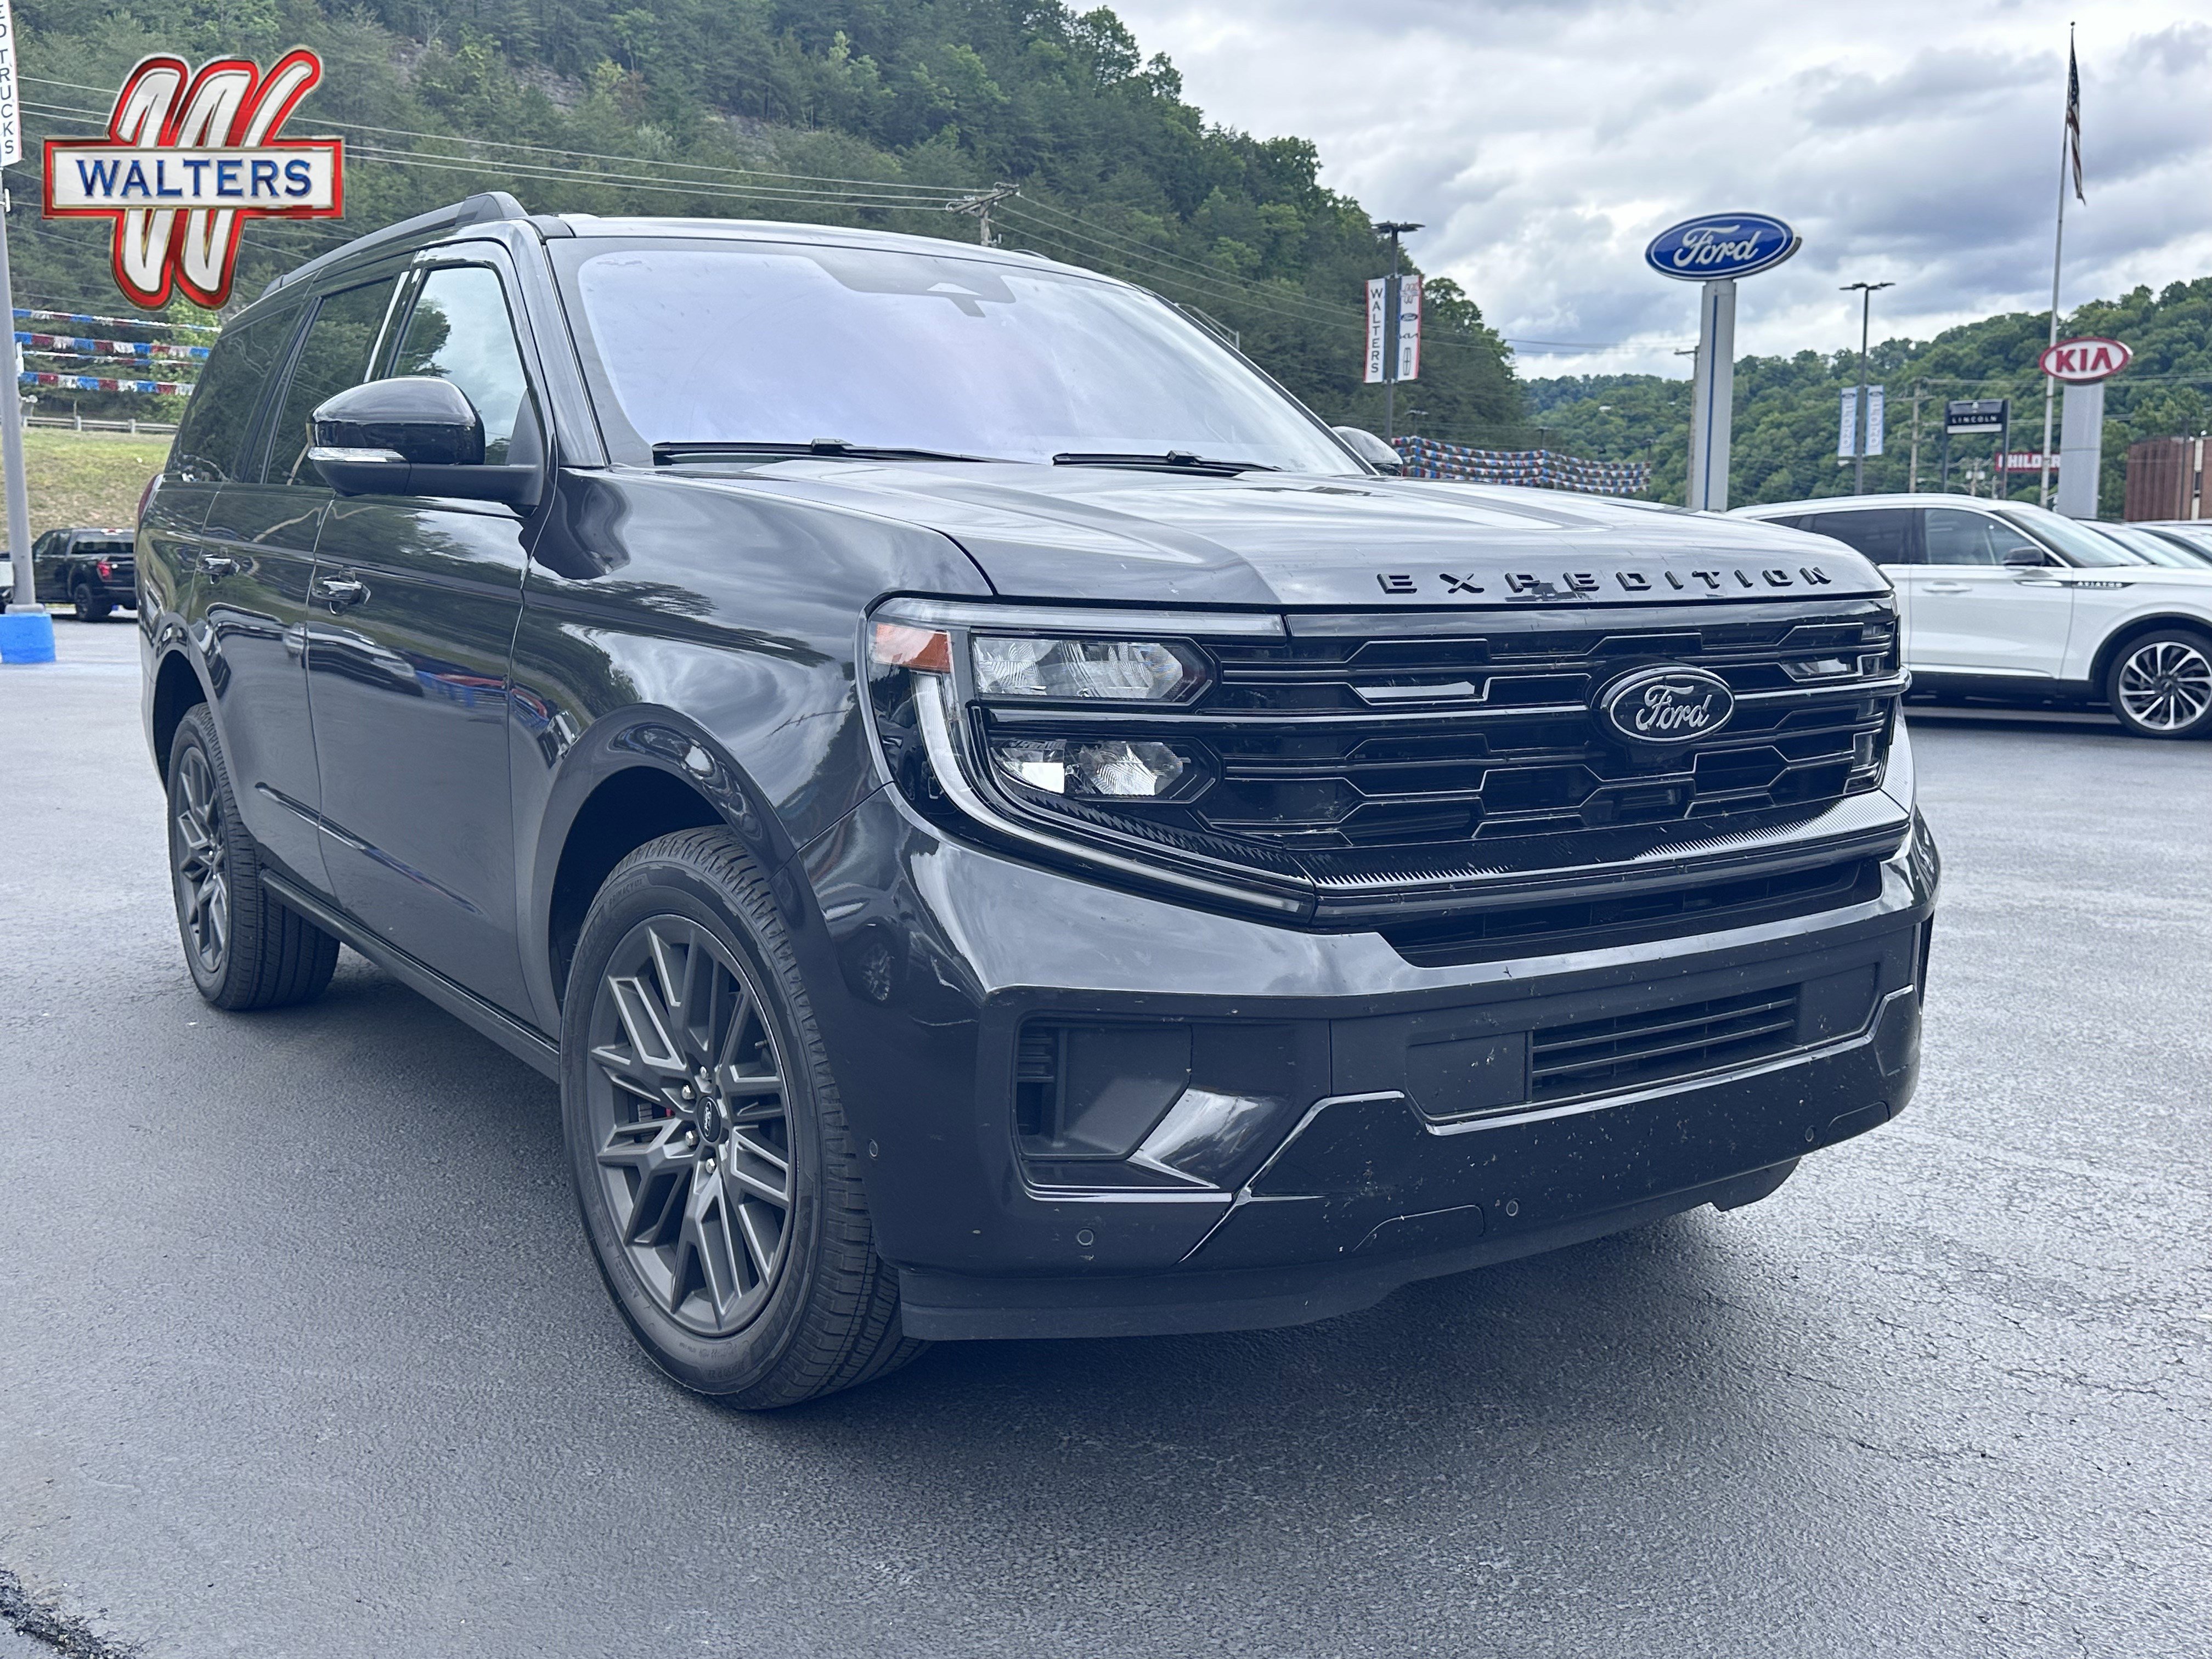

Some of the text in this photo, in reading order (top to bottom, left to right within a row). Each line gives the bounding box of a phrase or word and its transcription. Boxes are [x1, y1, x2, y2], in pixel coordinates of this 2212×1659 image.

[1673, 225, 1761, 267] Ford
[1370, 287, 1383, 374] WALTERS
[2055, 347, 2112, 373] KIA
[1952, 415, 1997, 424] LINCOLN
[1376, 566, 1831, 592] EXPEDITION
[1636, 685, 1711, 731] Ford
